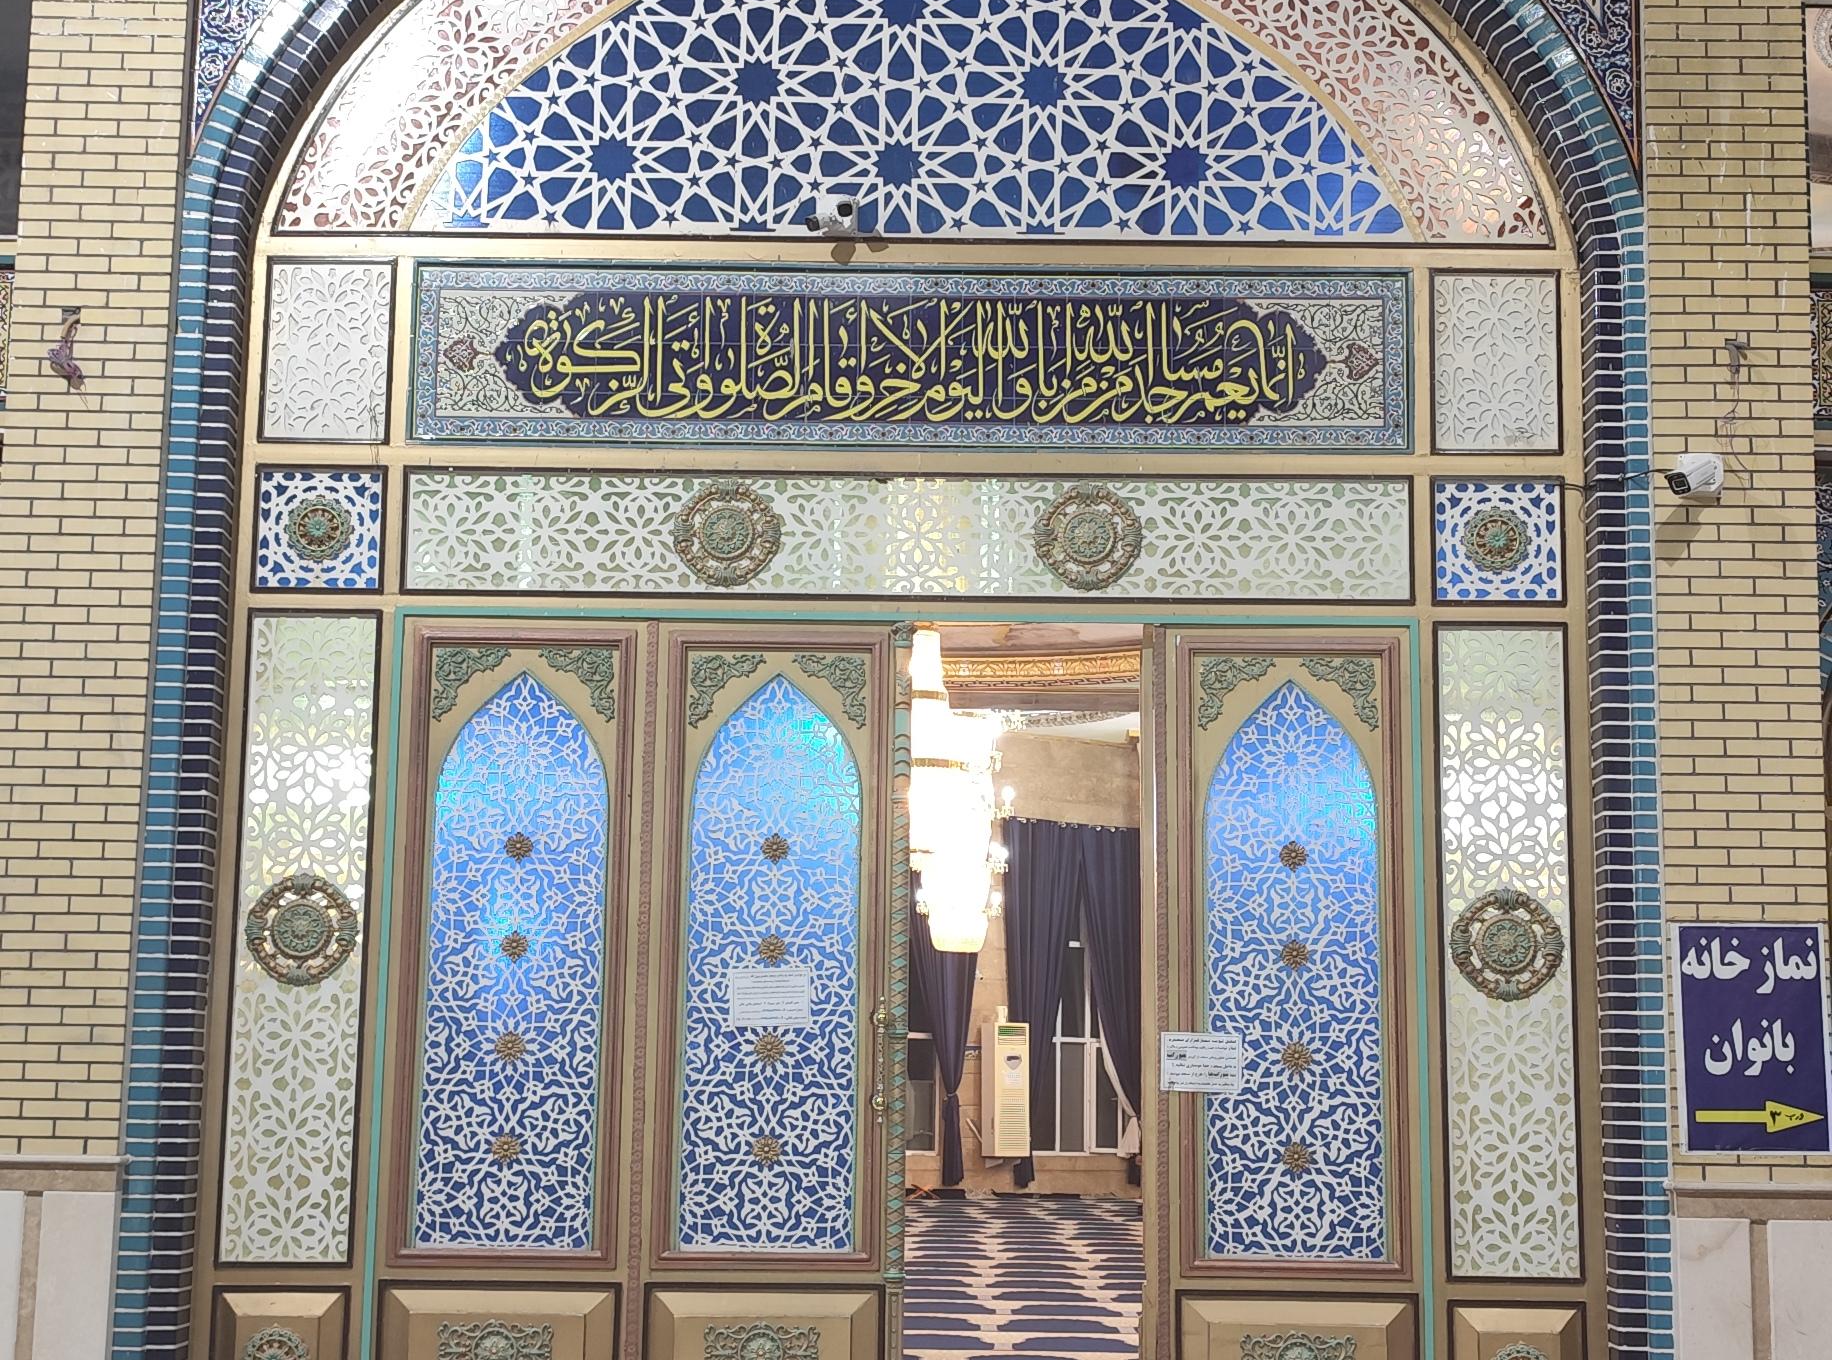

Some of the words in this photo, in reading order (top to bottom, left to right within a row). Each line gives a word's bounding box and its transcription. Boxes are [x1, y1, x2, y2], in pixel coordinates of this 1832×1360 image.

[1681, 935, 1751, 981] خانه
[1756, 936, 1818, 994] نماز
[1704, 1018, 1796, 1076] بانوان
